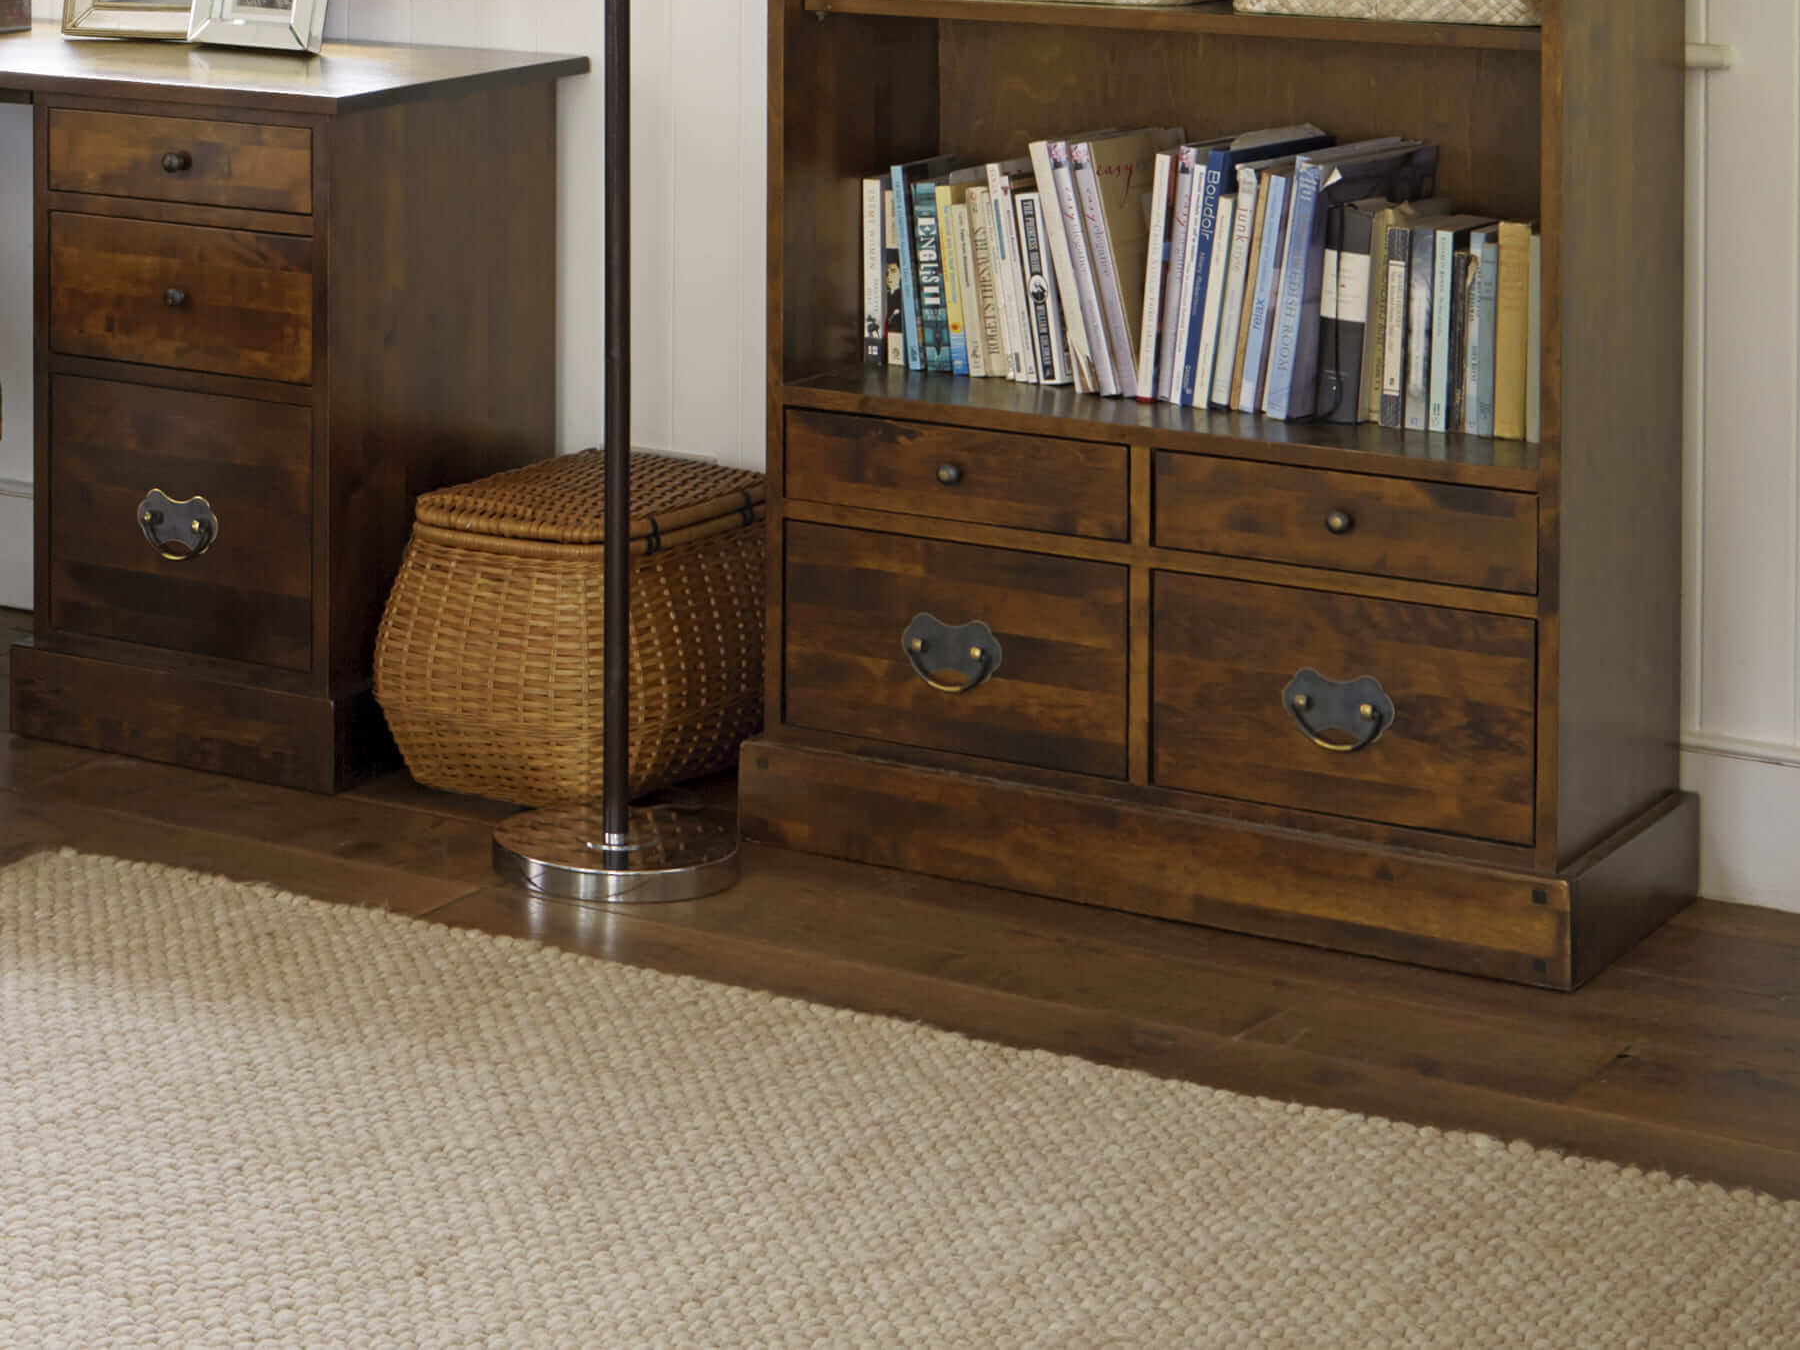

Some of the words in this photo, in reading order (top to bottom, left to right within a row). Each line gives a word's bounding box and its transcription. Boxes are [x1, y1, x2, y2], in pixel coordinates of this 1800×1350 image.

[1096, 162, 1134, 208] easy
[1201, 169, 1221, 241] Boudoir
[1236, 206, 1249, 242] junk
[974, 226, 996, 299] THESAURUS
[1253, 297, 1265, 331] relax
[1277, 325, 1294, 371] ROOM
